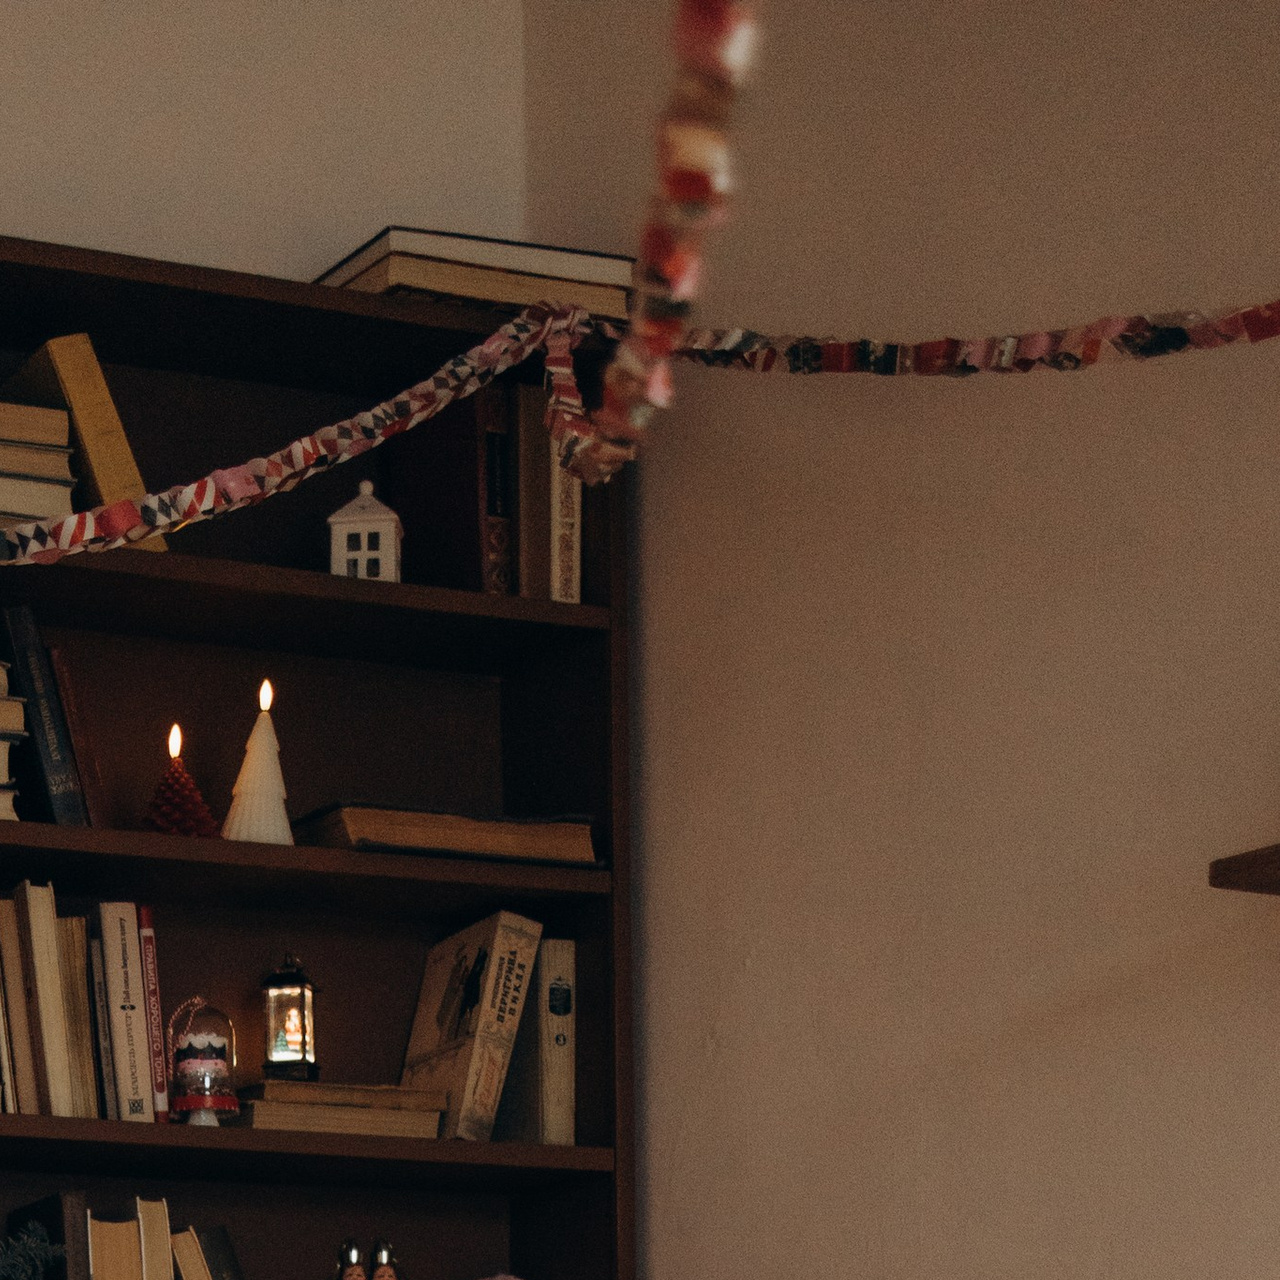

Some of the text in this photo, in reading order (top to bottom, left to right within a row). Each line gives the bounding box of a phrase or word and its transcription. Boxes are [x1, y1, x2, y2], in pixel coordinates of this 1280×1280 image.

[123, 1013, 134, 1047] ПРУСТ
[144, 943, 164, 1083] ПРАВИЛА ХОРОШЕГО ТОНА
[127, 1047, 139, 1096] МАРСЕЛЬ
